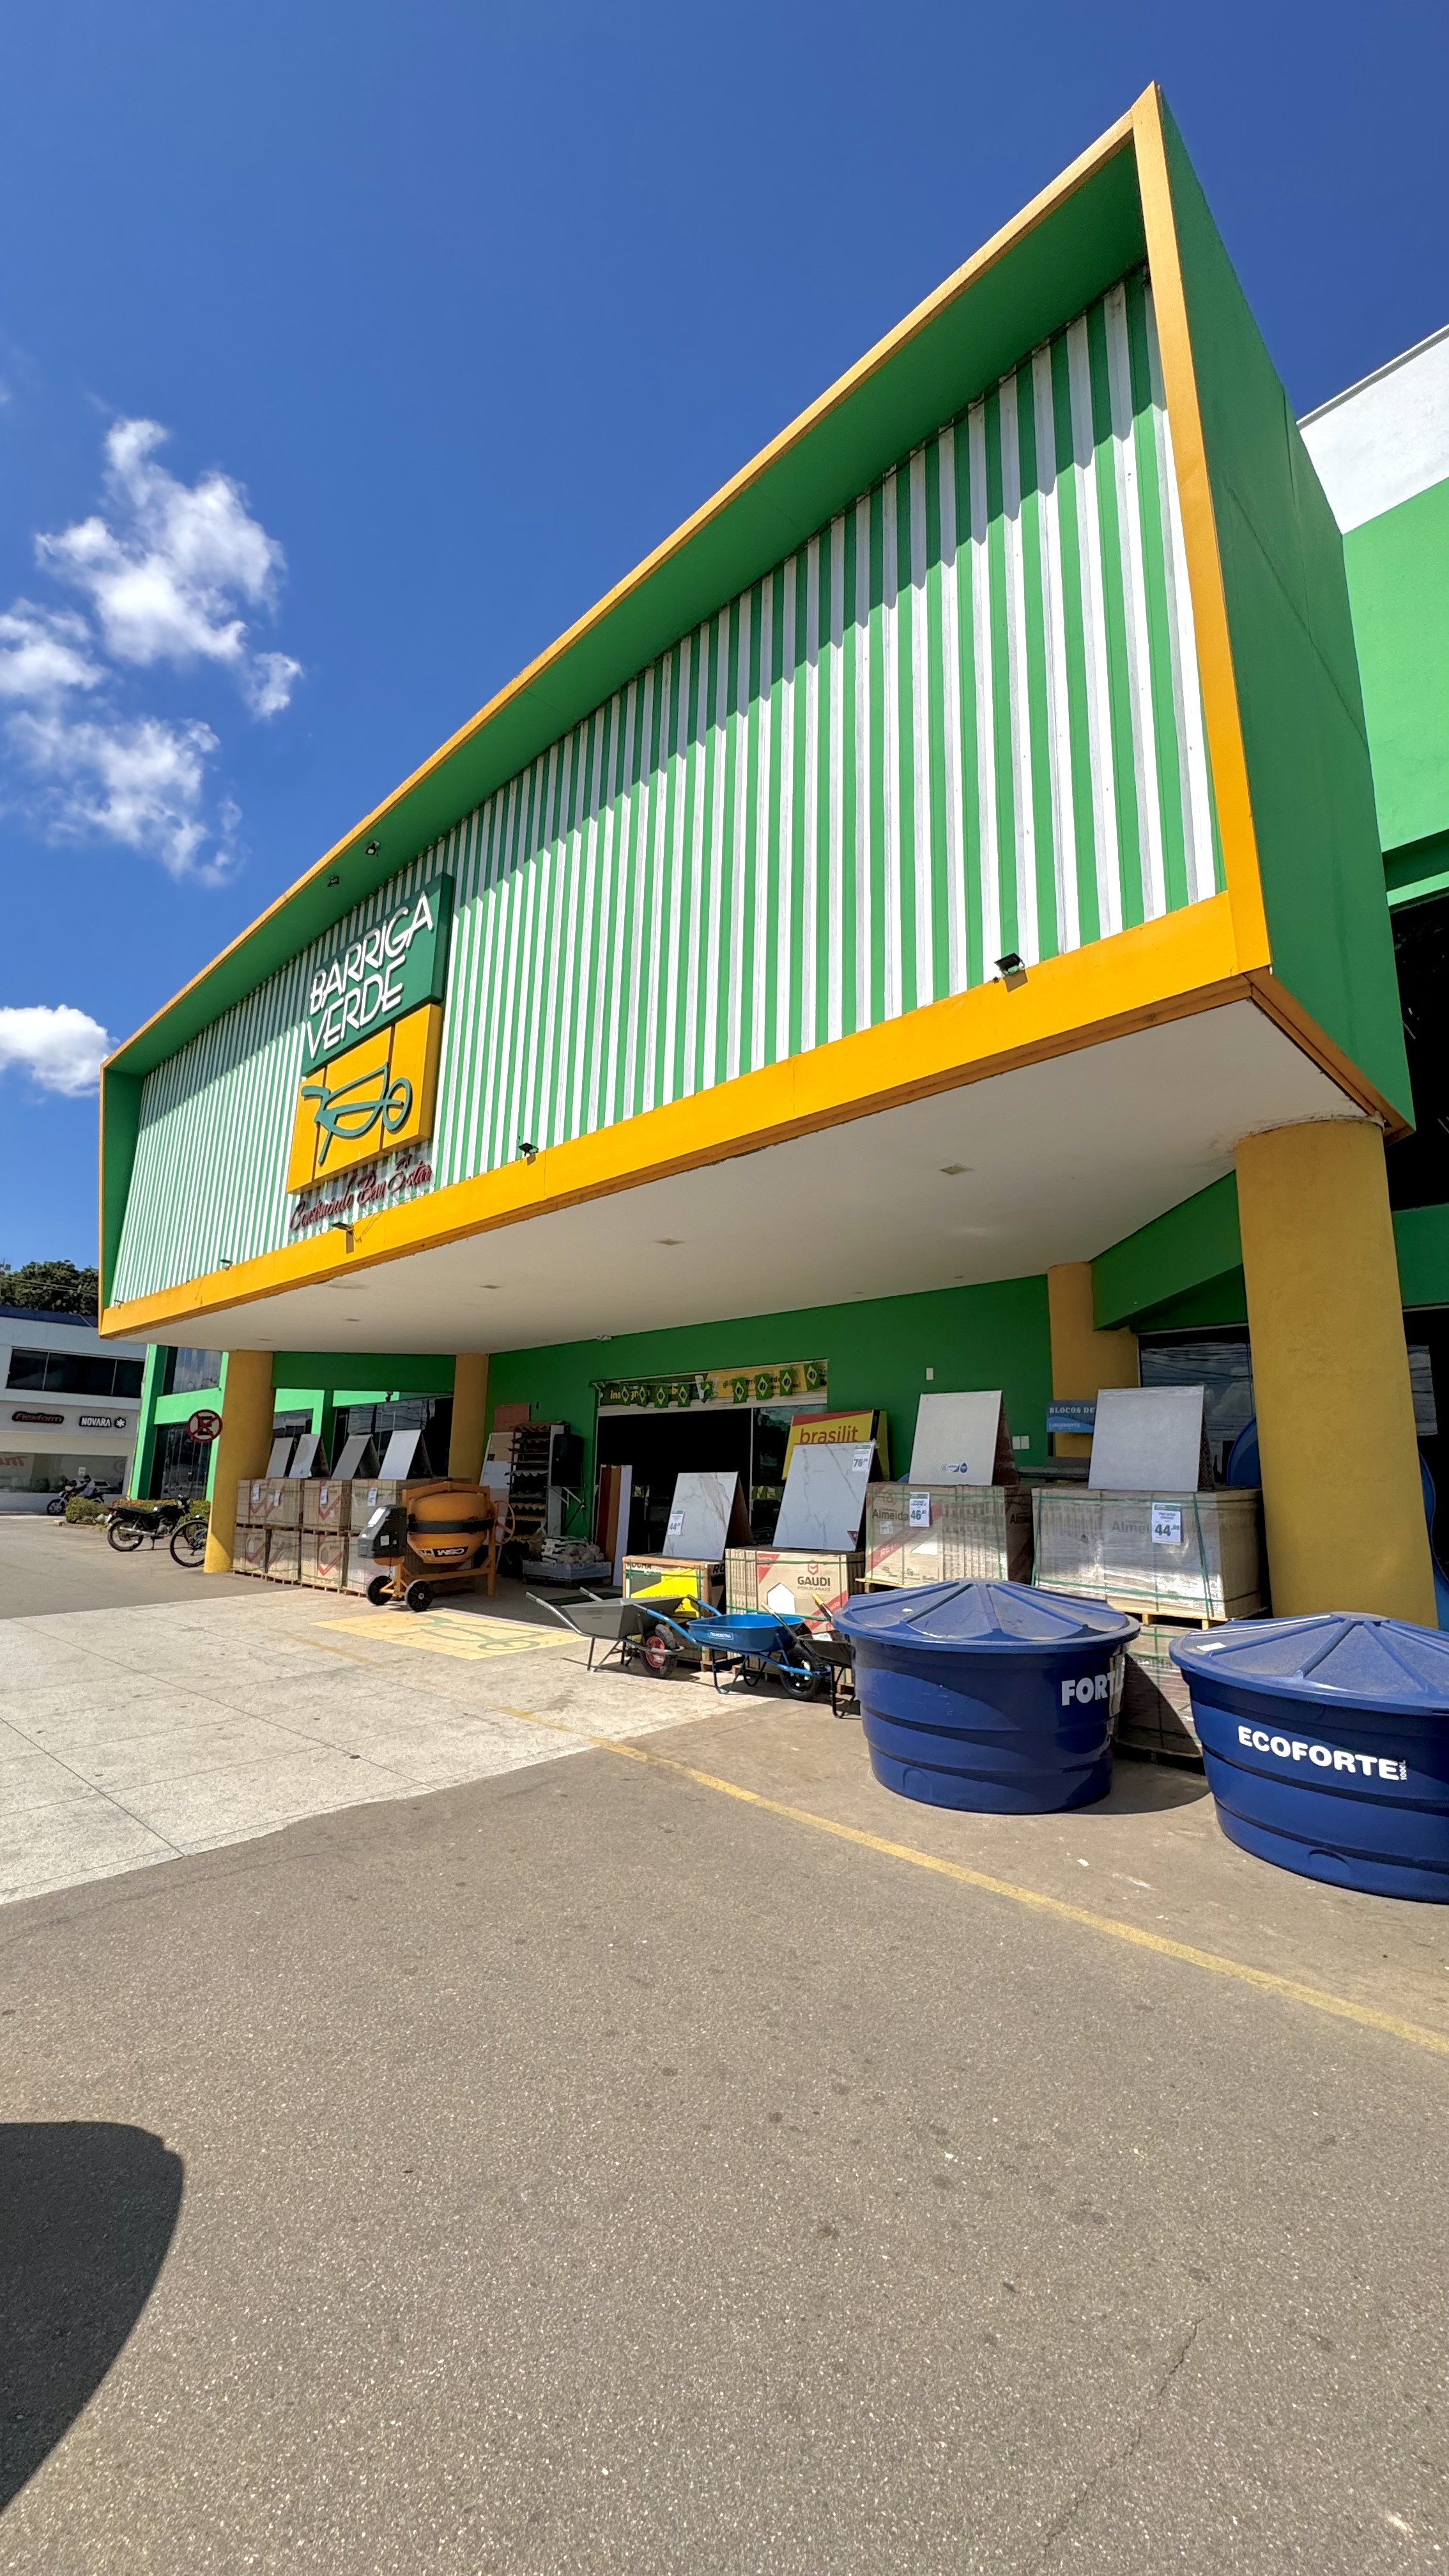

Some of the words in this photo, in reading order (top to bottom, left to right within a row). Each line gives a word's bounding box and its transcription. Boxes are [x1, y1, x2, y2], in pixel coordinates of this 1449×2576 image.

[310, 890, 433, 1016] BARRIGA
[307, 954, 406, 1059] VERDE
[80, 1416, 111, 1427] NOVARA
[799, 1425, 858, 1443] brasilit
[872, 1508, 908, 1521] Almeida
[797, 1576, 831, 1586] GAUDI
[1238, 1726, 1400, 1781] ECOFORTE
